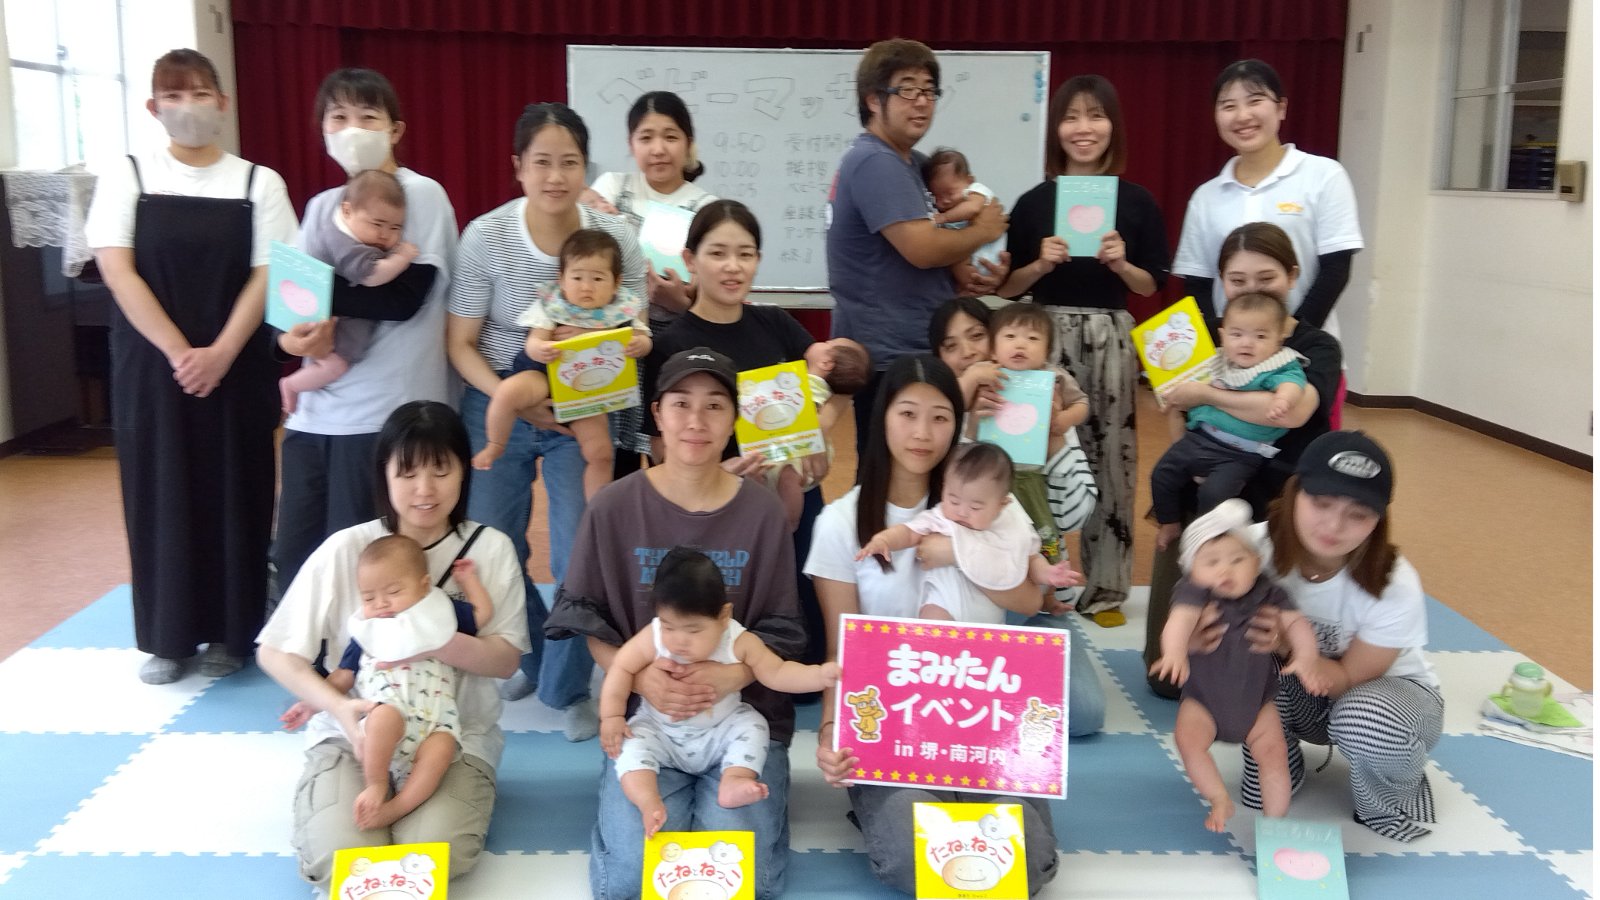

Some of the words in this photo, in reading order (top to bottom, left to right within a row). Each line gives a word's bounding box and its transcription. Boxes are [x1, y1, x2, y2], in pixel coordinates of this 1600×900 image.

[887, 643, 1022, 694] まみたん
[890, 693, 1015, 732] イベント
[894, 740, 913, 757] in
[919, 741, 1008, 766] 堺・南河内
[929, 836, 1013, 865] たねとねっこ
[657, 862, 741, 888] たねとねっこ
